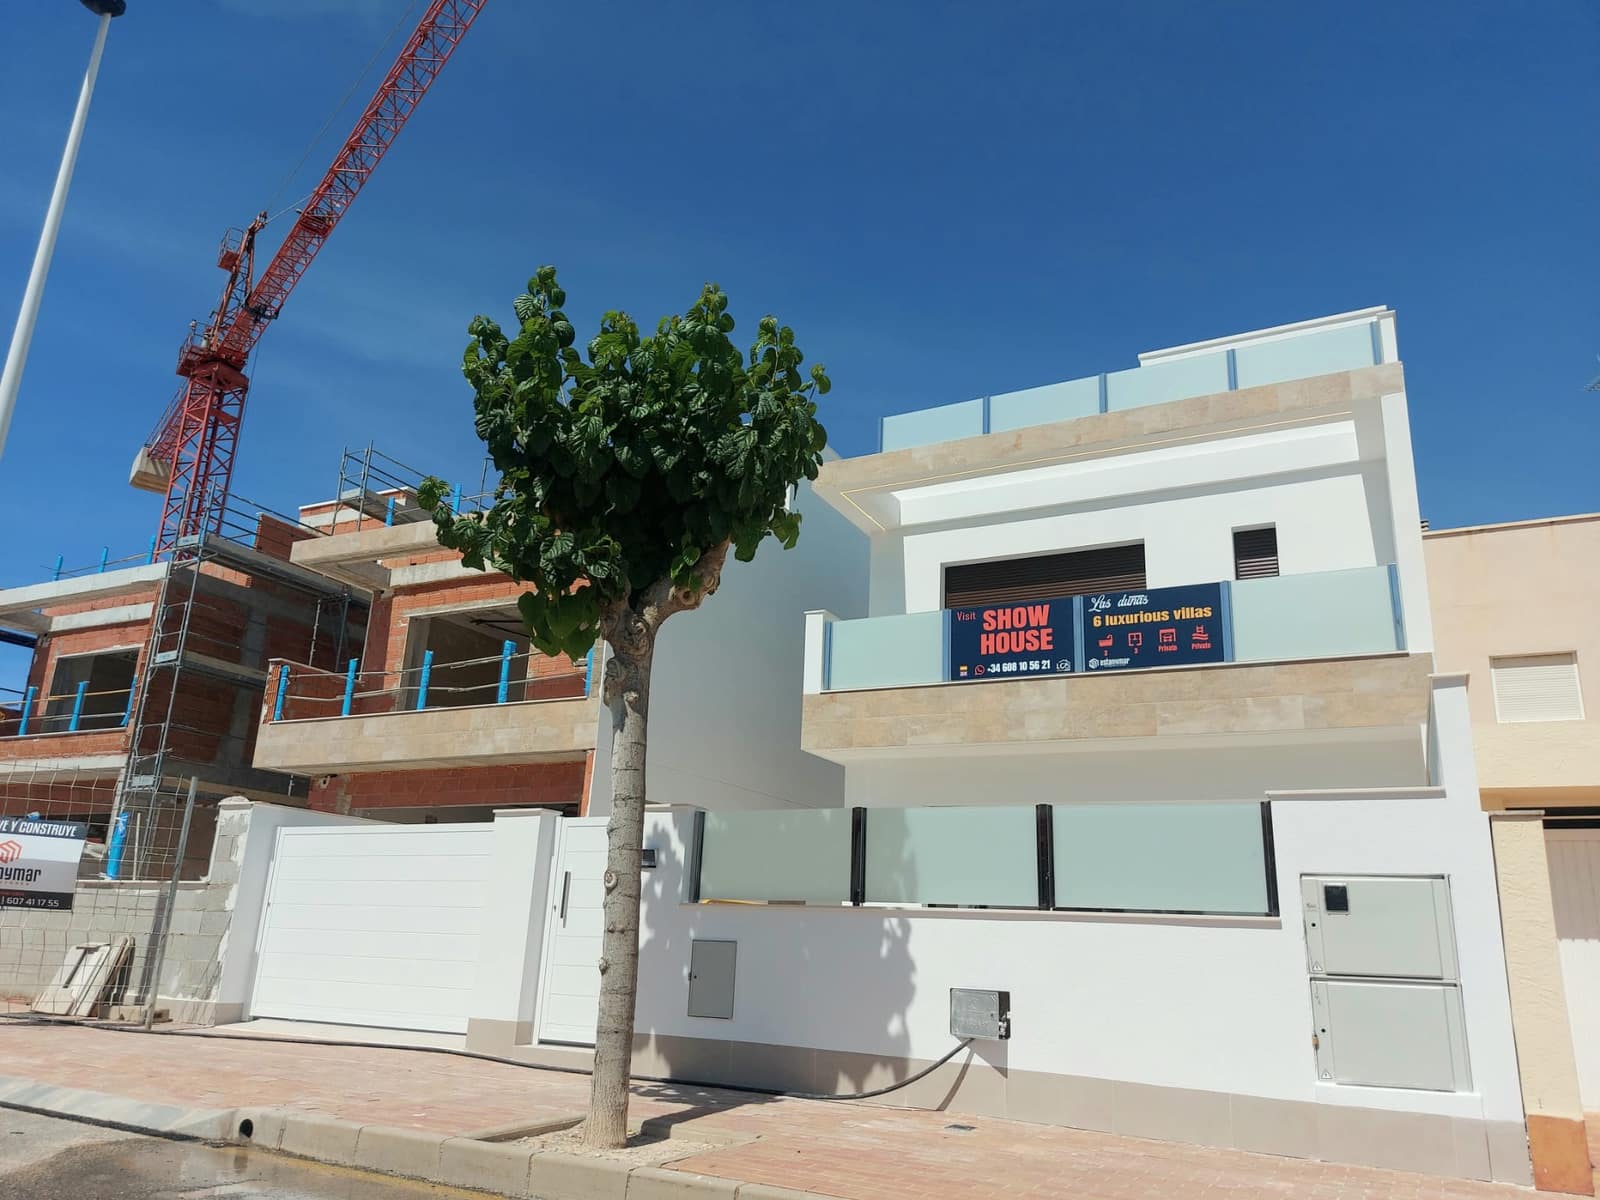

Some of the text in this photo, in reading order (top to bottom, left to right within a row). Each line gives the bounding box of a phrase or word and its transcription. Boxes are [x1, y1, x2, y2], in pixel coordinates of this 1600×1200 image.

[1088, 595, 1111, 612] Las
[957, 611, 976, 621] Visit
[982, 604, 1050, 631] SHOW
[1093, 606, 1212, 627] 6 luxurious villas
[980, 628, 1054, 655] HOUSE
[1018, 661, 1028, 671] 10
[1041, 659, 1051, 670] 21
[11, 819, 18, 832] Y
[18, 821, 77, 837] CONSTRUYE
[6, 896, 24, 905] 607
[38, 898, 47, 906] 17
[47, 899, 60, 907] 55
